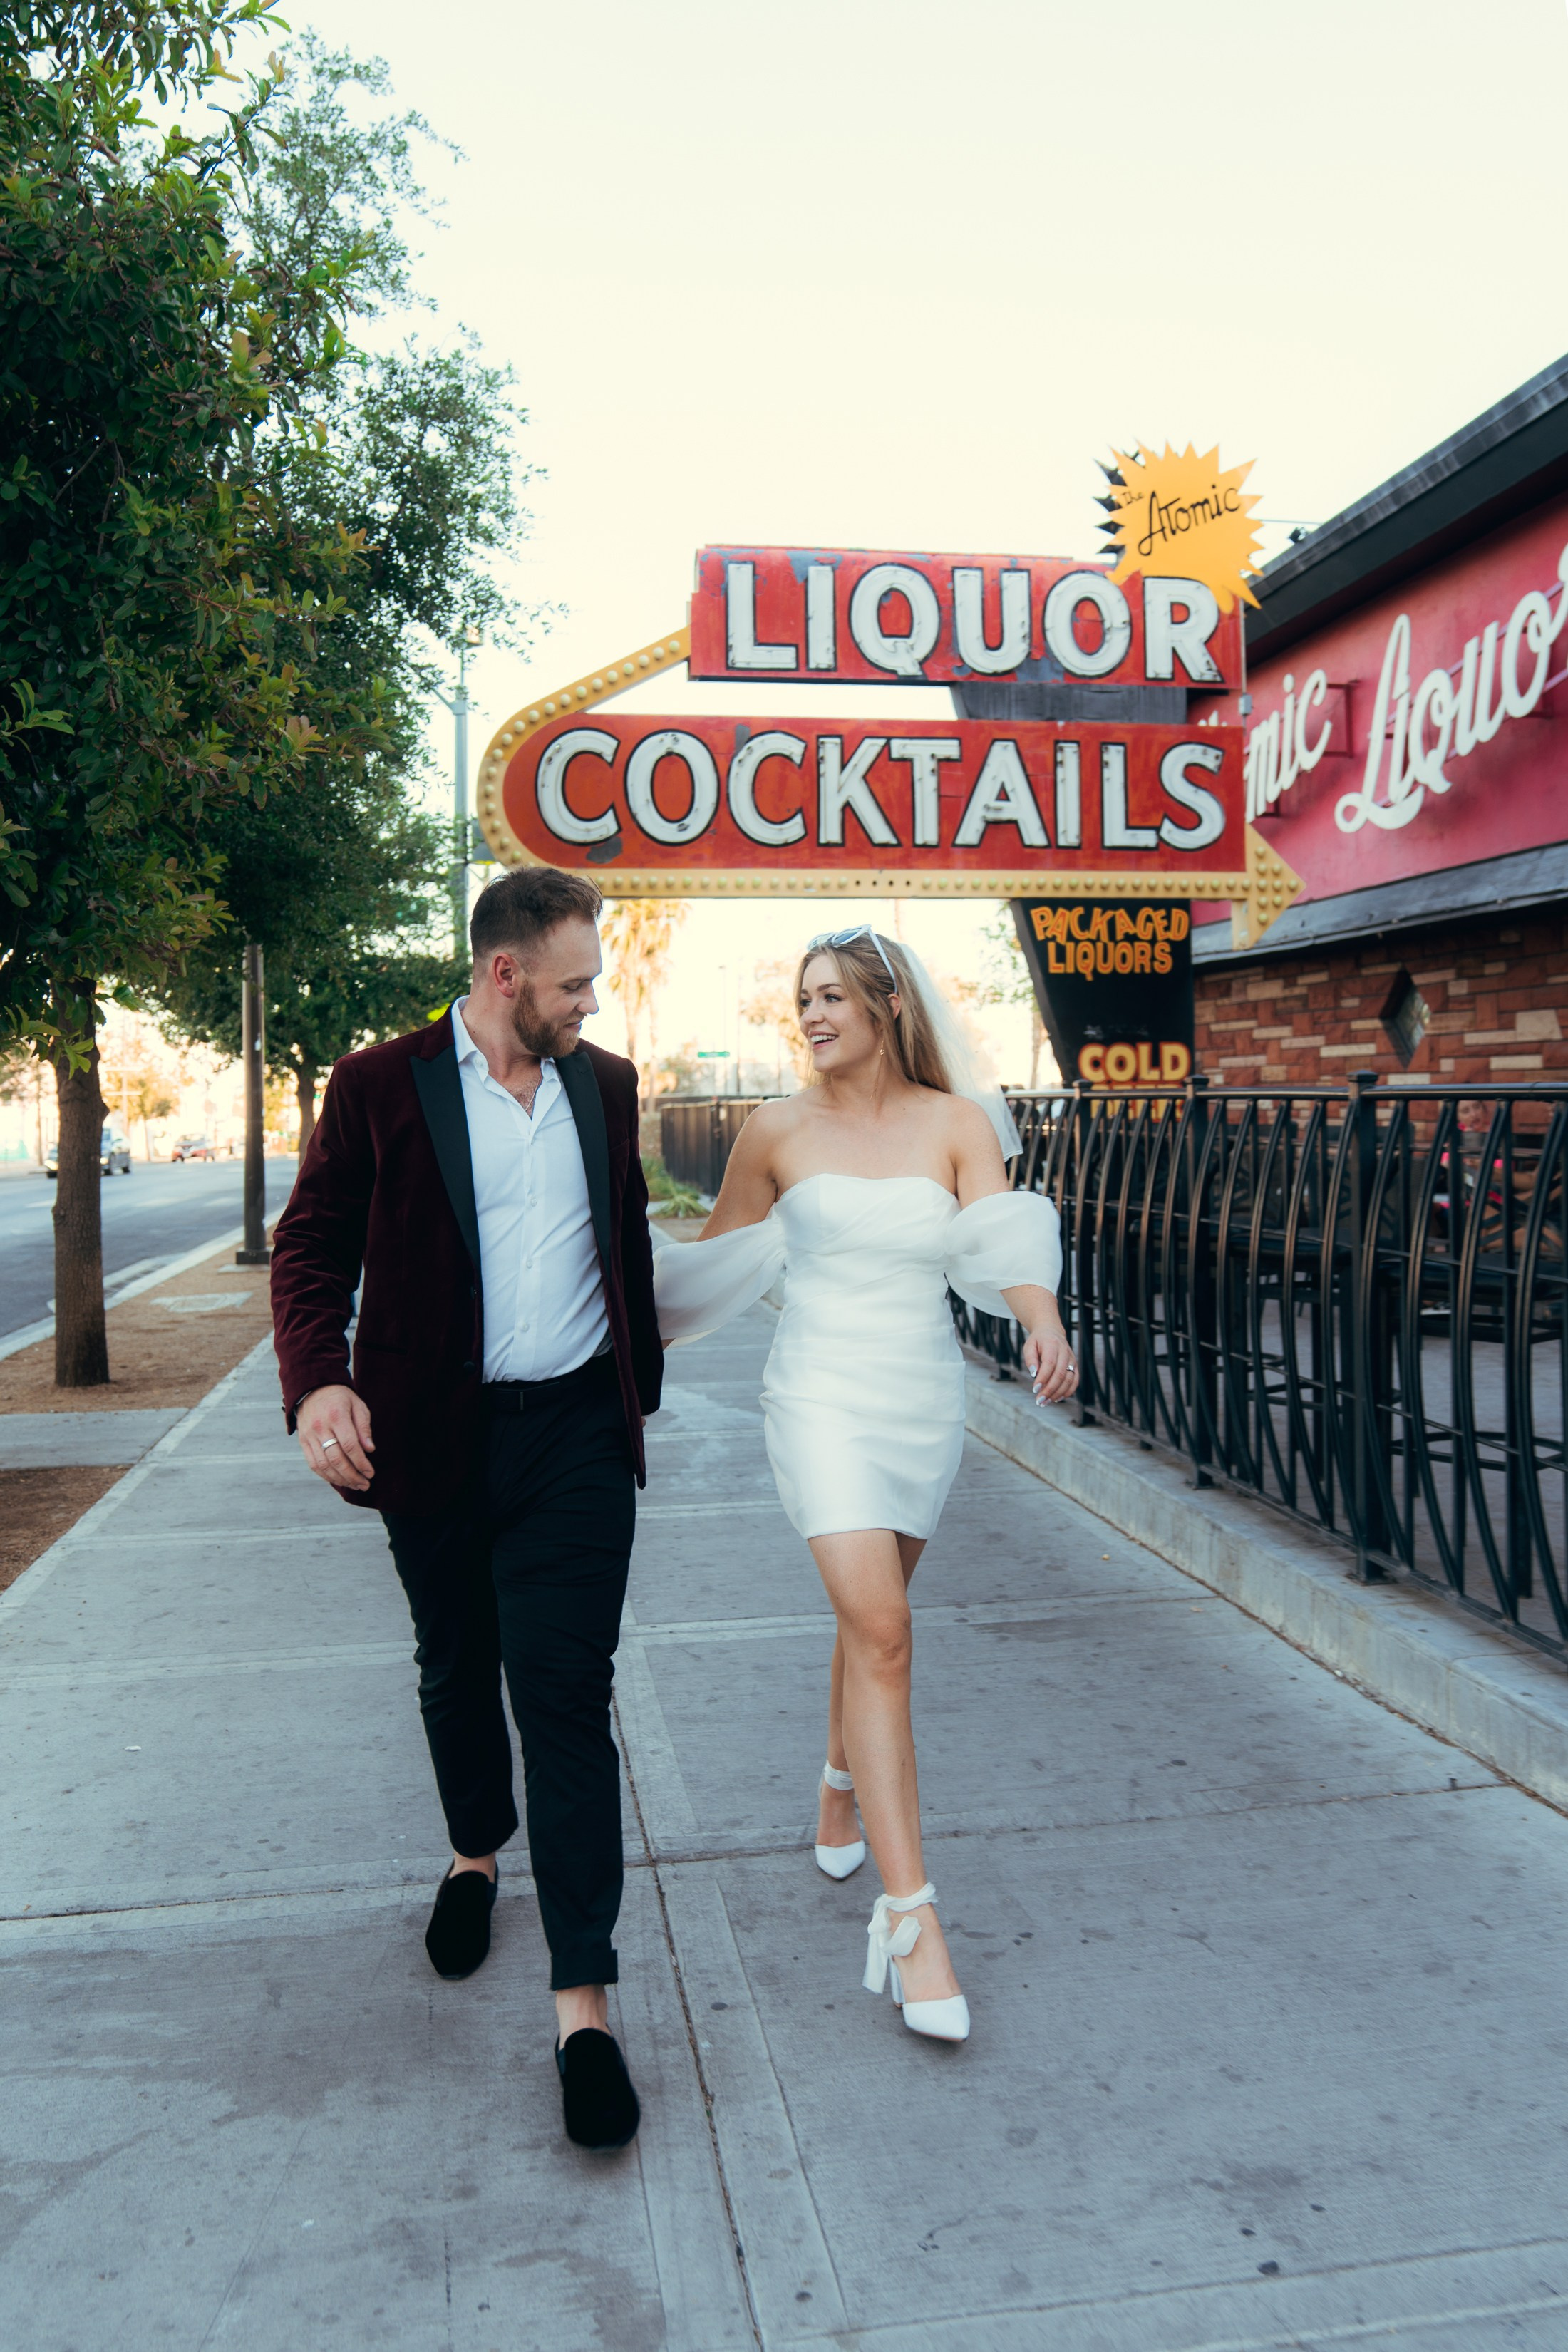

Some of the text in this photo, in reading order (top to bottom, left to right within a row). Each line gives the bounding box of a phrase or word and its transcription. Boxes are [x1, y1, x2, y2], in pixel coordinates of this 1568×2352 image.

[1138, 483, 1242, 556] Atomic
[726, 561, 1224, 684] LIQUOR
[1198, 542, 1568, 832] mic Liquo
[535, 727, 1227, 852] COCKTAILS
[1030, 906, 1190, 946] PACKAGED
[1047, 941, 1173, 981] LIQUORS
[1077, 1041, 1191, 1083] COLD
